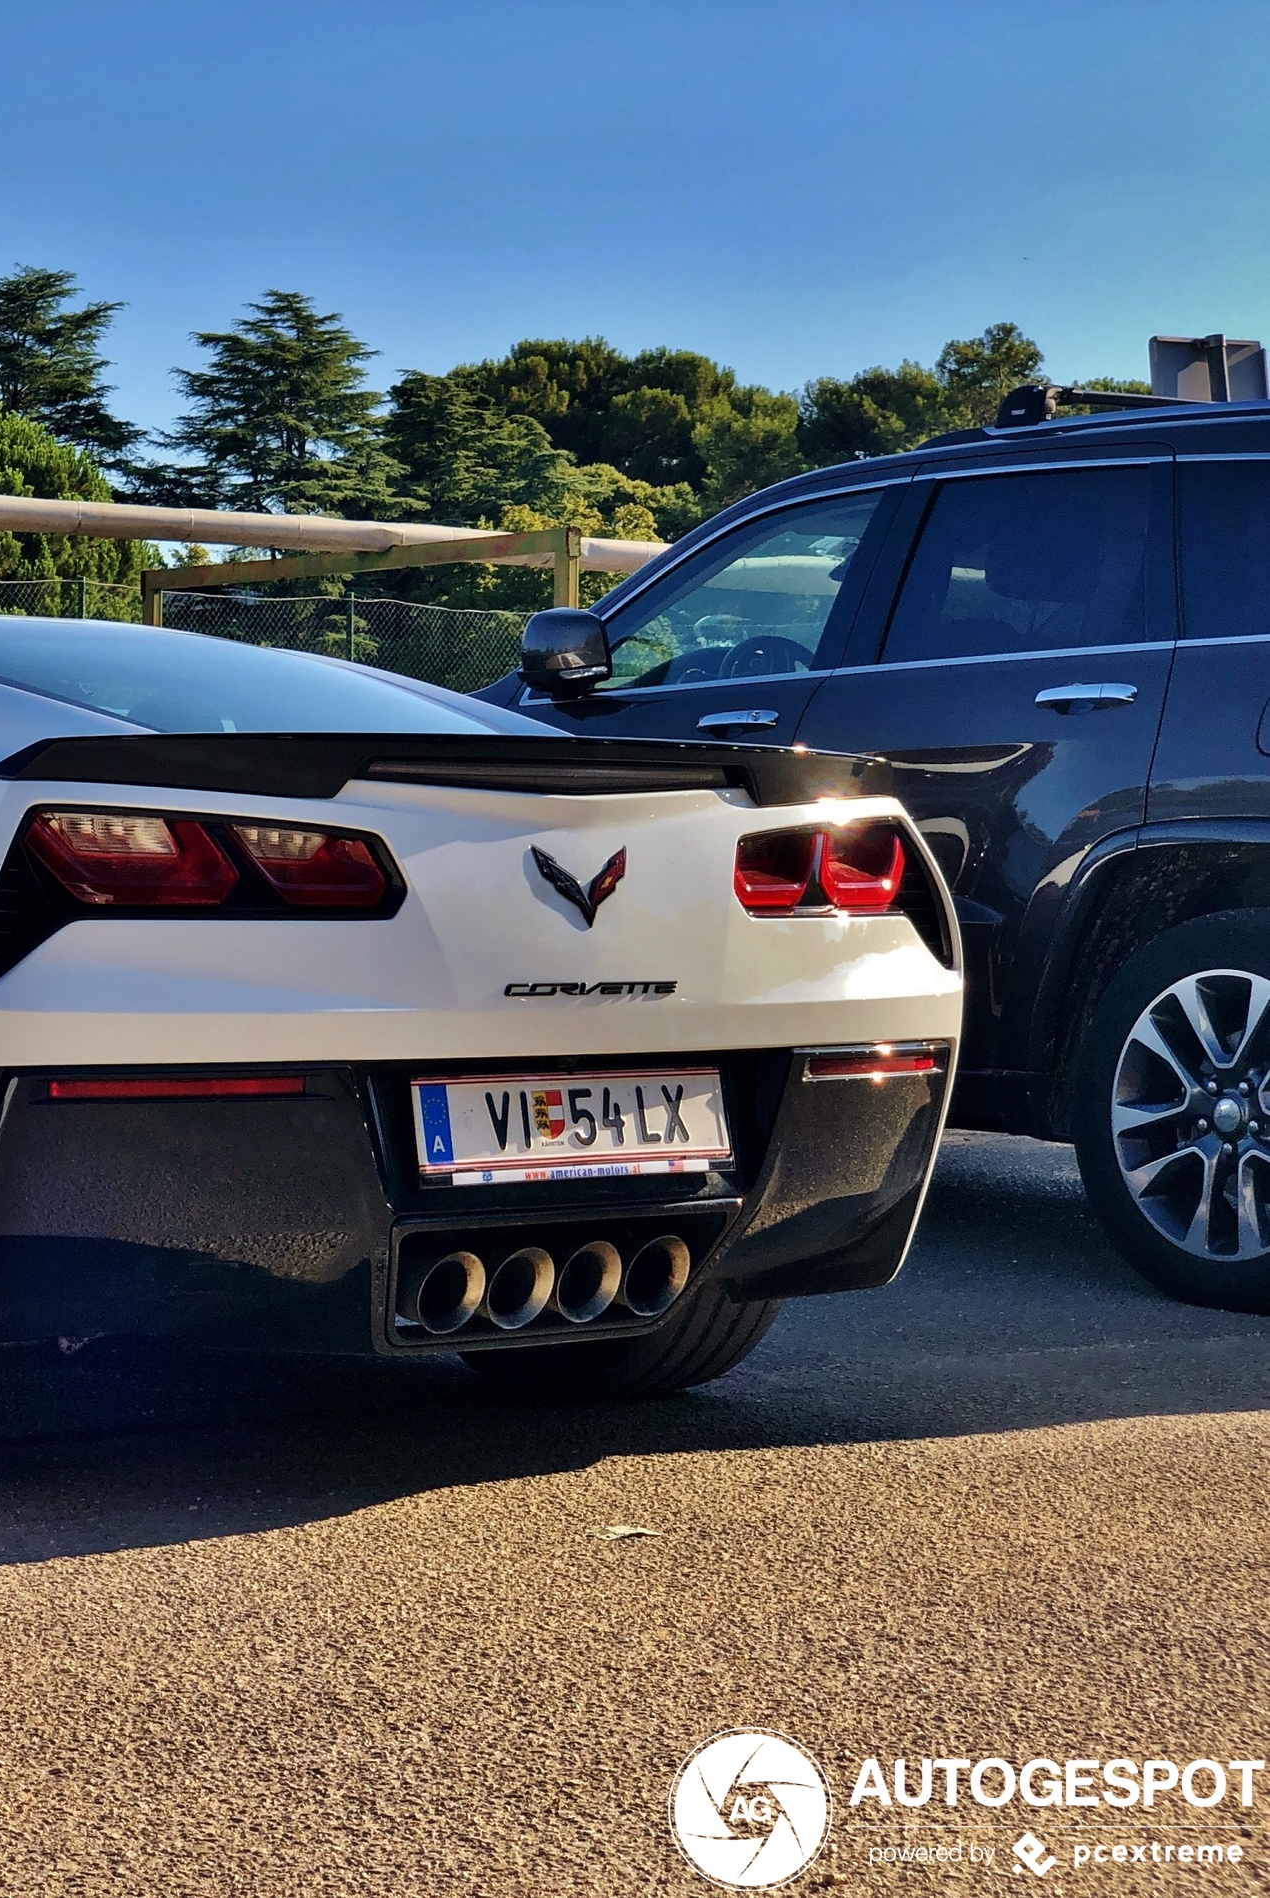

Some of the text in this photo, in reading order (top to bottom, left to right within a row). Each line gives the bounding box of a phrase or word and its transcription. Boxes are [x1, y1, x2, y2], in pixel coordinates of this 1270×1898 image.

[503, 980, 678, 997] CORVETTE
[484, 1090, 532, 1151] VI
[432, 1135, 446, 1153] A
[524, 1163, 642, 1181] www.american-motors.at
